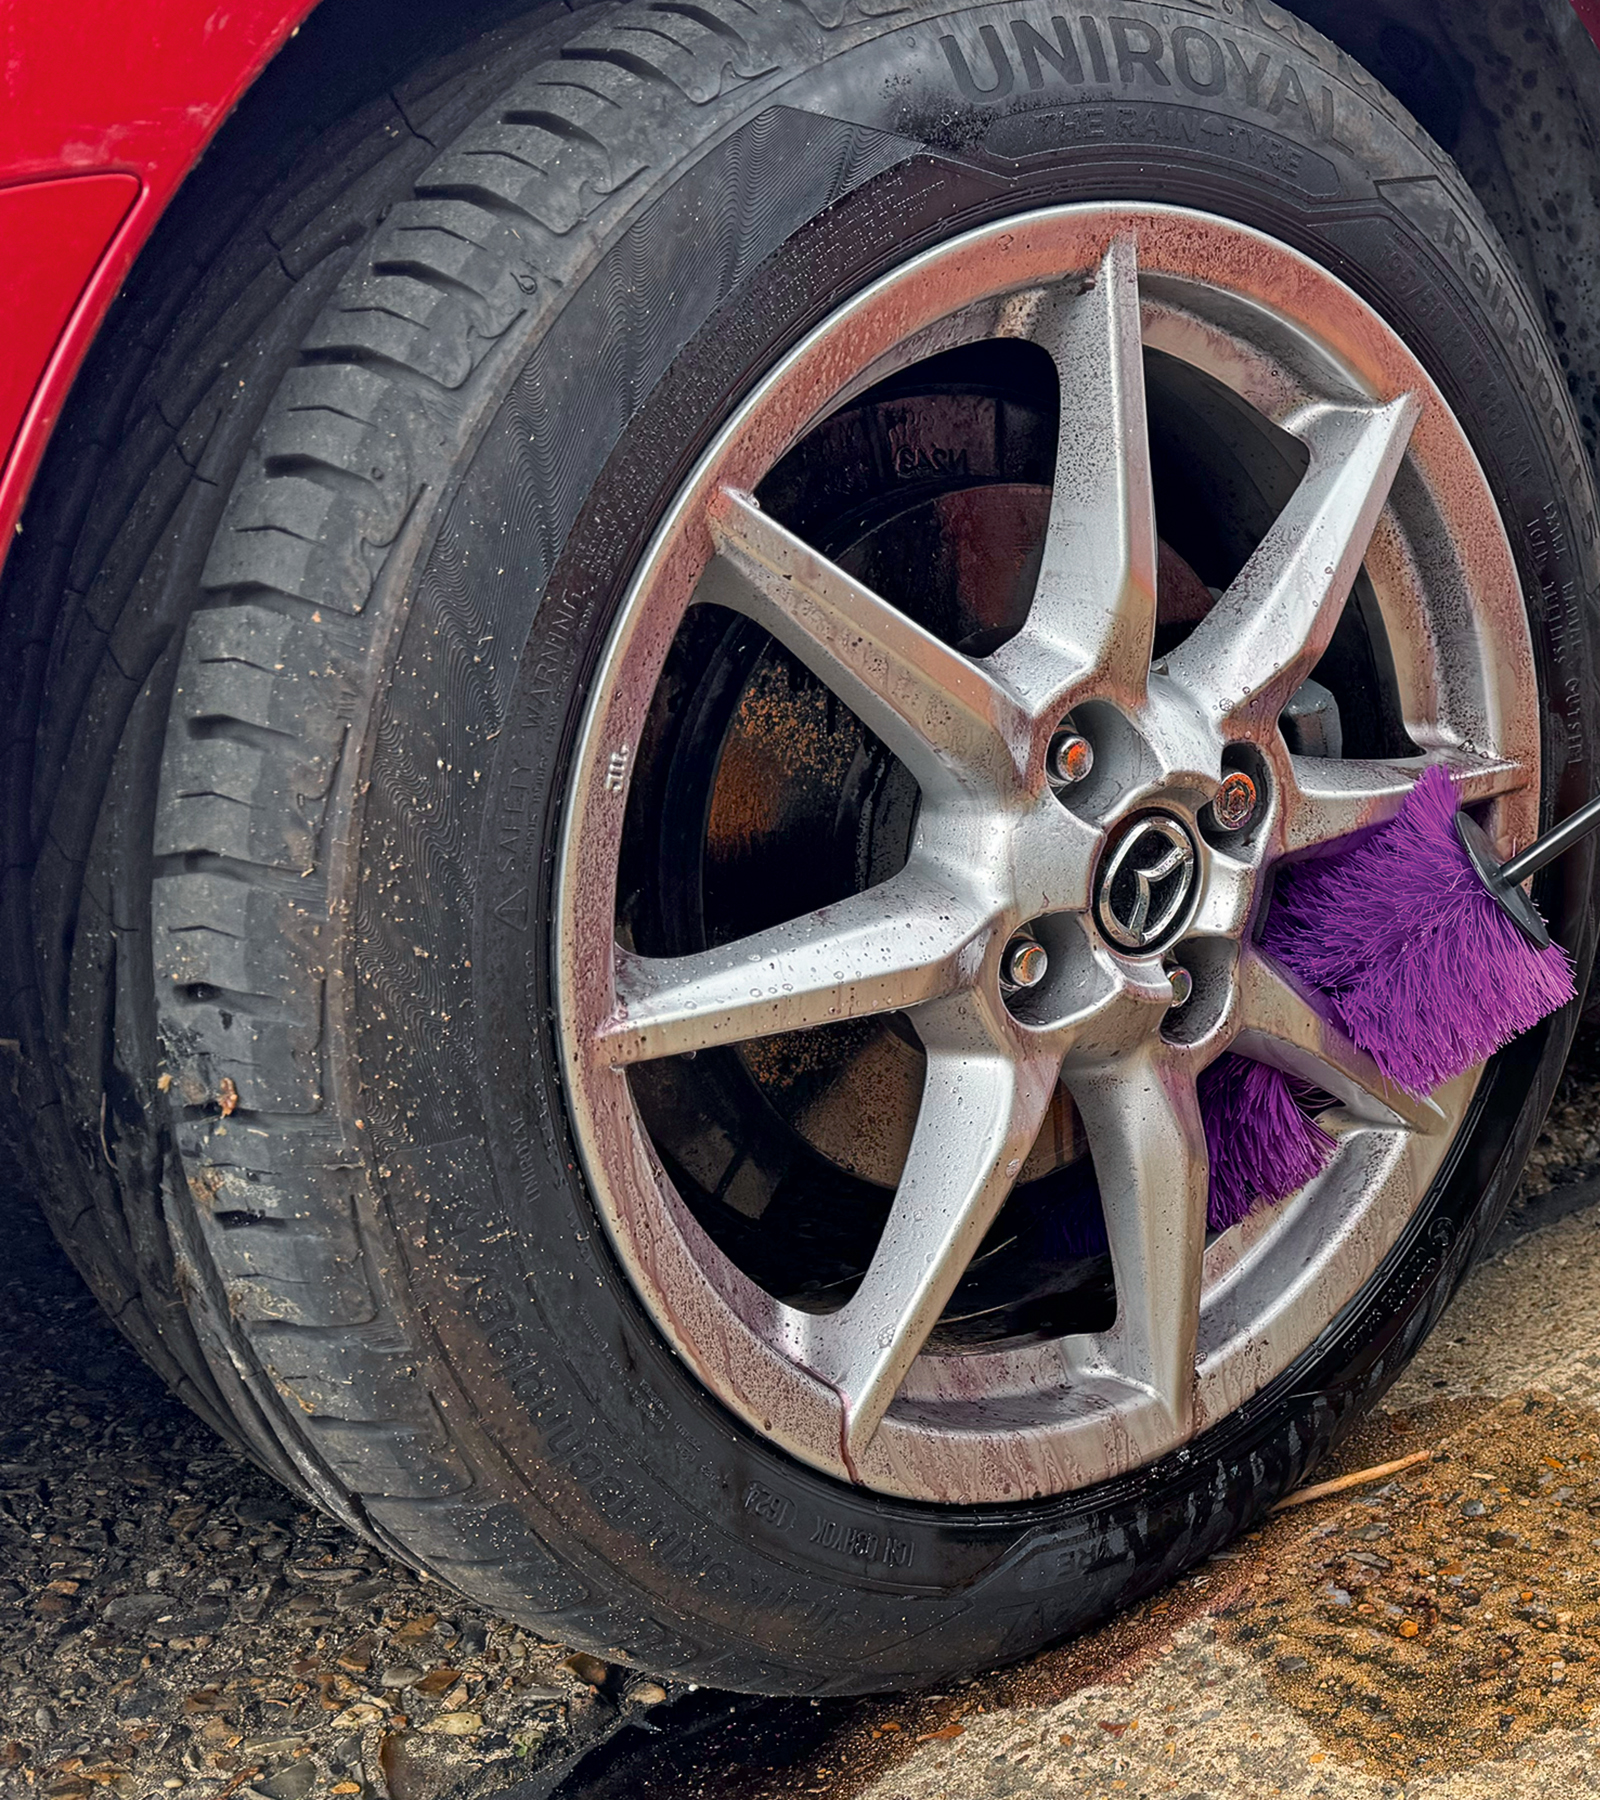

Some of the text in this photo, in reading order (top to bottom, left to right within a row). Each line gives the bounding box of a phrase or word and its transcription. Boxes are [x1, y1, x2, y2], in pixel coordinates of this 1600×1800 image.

[938, 14, 1355, 156] UNIROYAL
[1034, 107, 1303, 178] THE RAIN TYRE
[496, 584, 583, 872] SAFETY WARNING
[506, 1111, 543, 1205] UNIROYAL
[742, 1480, 790, 1529] 1624
